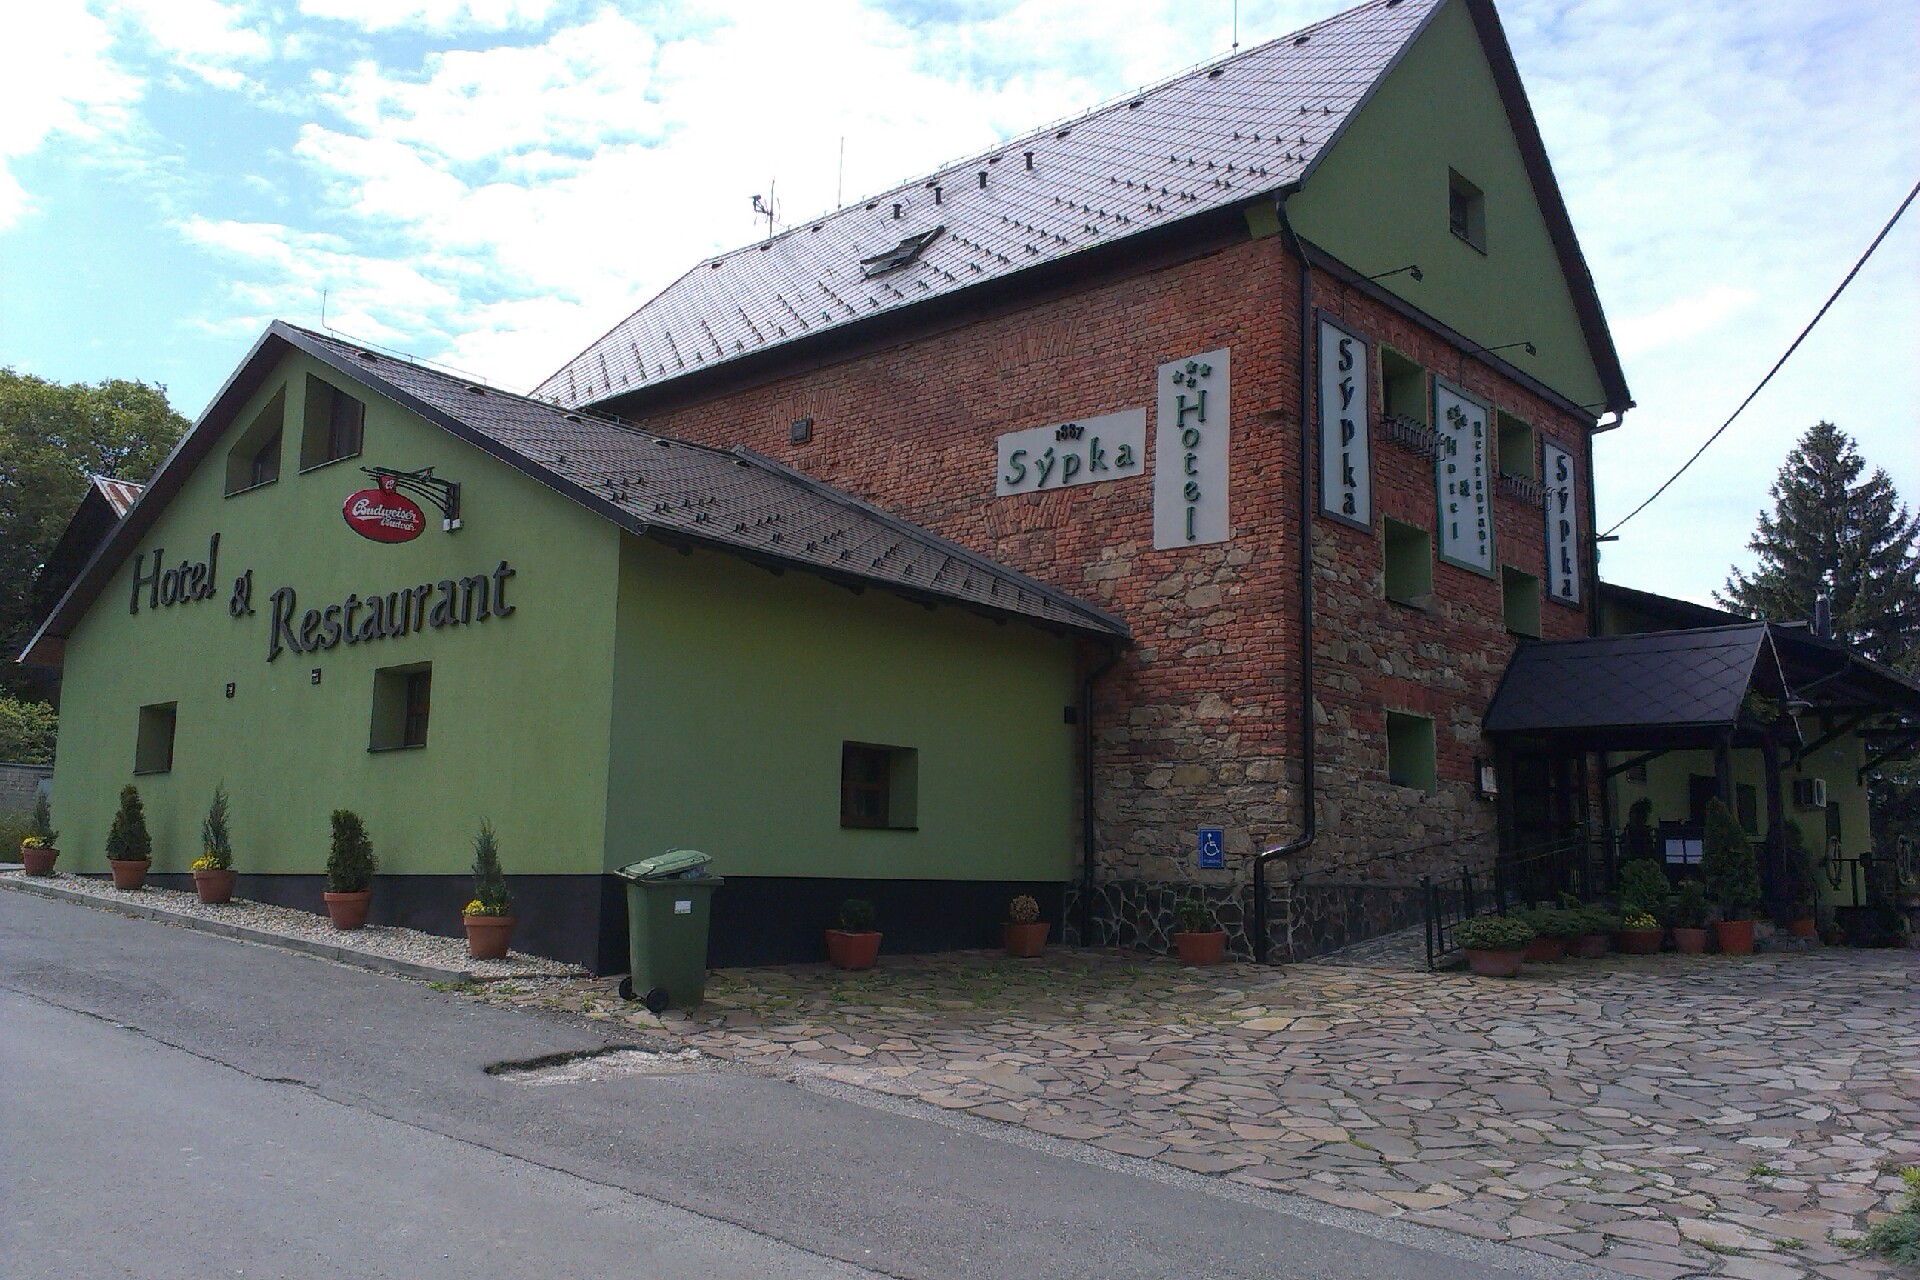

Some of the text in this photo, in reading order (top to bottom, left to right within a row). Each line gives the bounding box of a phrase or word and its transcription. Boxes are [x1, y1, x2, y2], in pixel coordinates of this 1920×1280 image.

[1003, 436, 1135, 488] Sýpka
[1175, 389, 1208, 542] Hotel
[351, 498, 419, 523] Budweiser
[129, 532, 517, 663] Hotel & Restaurant
